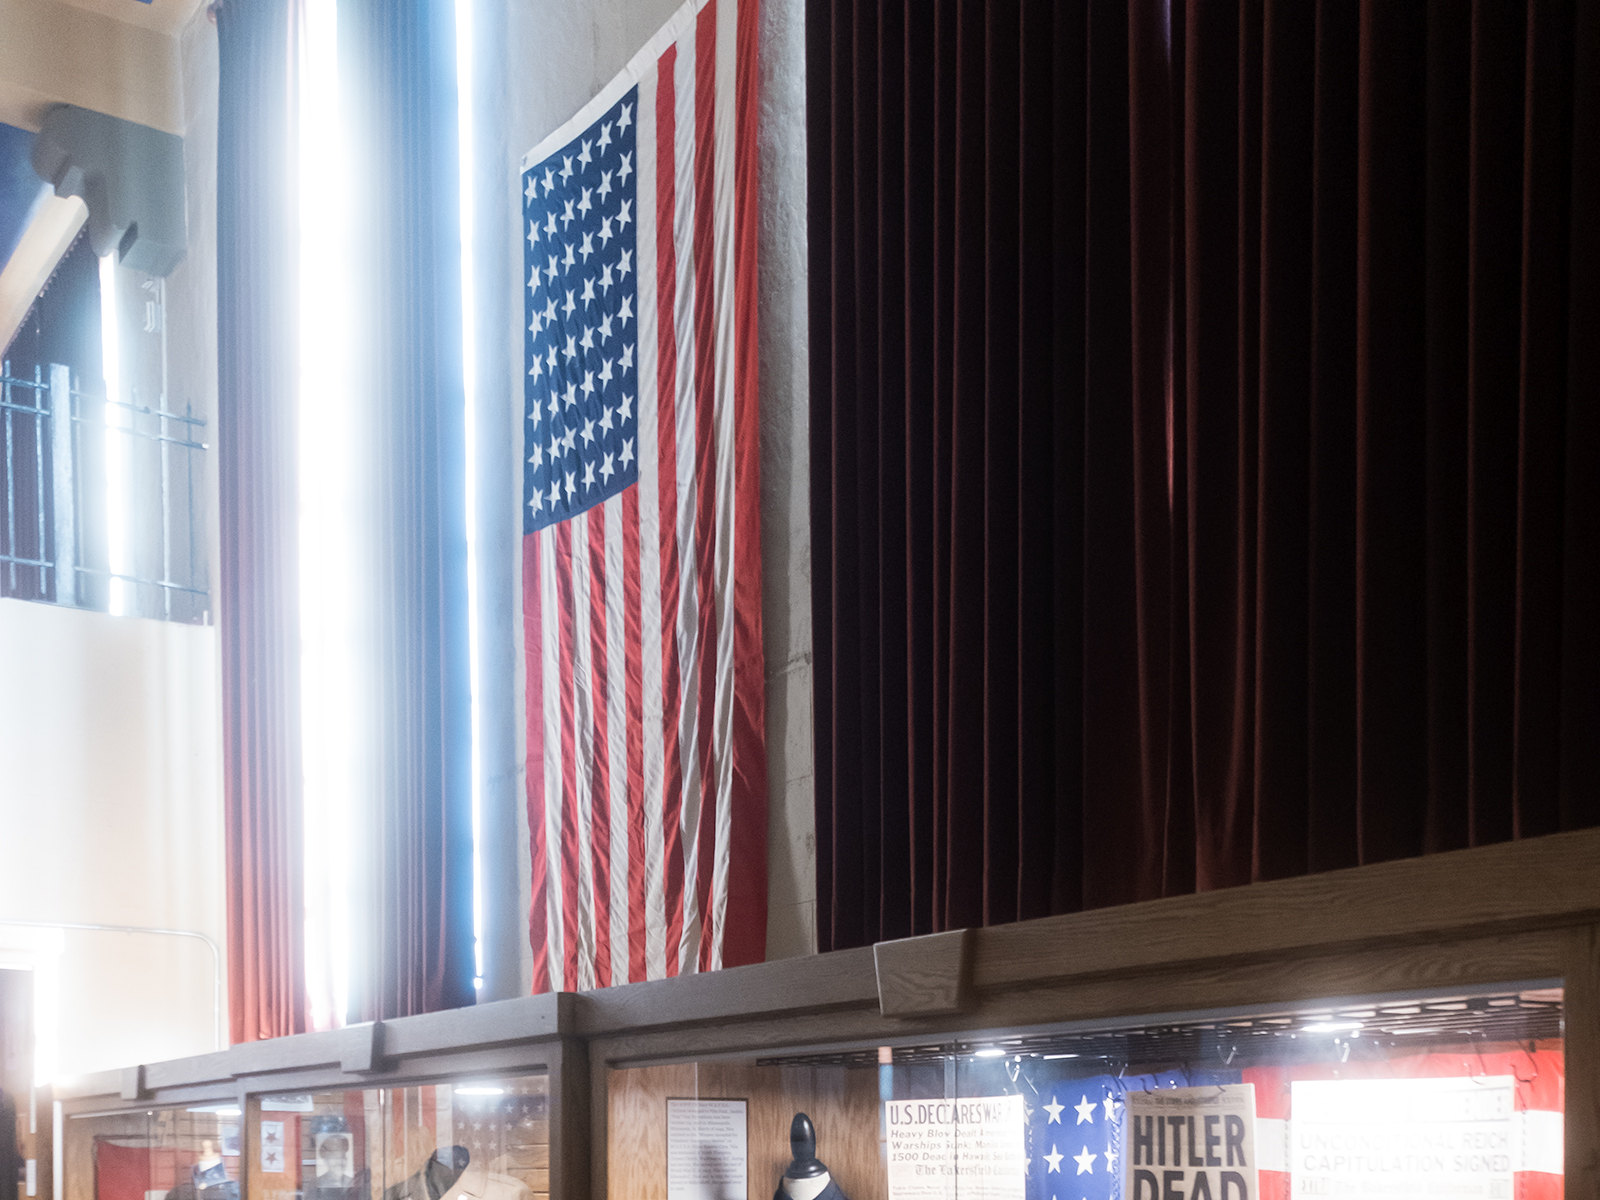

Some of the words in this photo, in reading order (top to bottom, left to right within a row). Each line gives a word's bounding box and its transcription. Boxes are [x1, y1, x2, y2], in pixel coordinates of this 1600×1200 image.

[890, 1105, 917, 1125] U.S.
[890, 1129, 923, 1140] Heavy
[954, 1129, 978, 1138] Dealt
[1133, 1115, 1247, 1167] HITLER
[1300, 1133, 1455, 1150] UNCONDITIONAL
[1462, 1132, 1509, 1150] REICH
[892, 1141, 942, 1151] Warships
[892, 1152, 919, 1162] 1500
[1304, 1155, 1445, 1172] CAPITULATION
[1453, 1155, 1510, 1172] SIGNED
[916, 1164, 936, 1176] The
